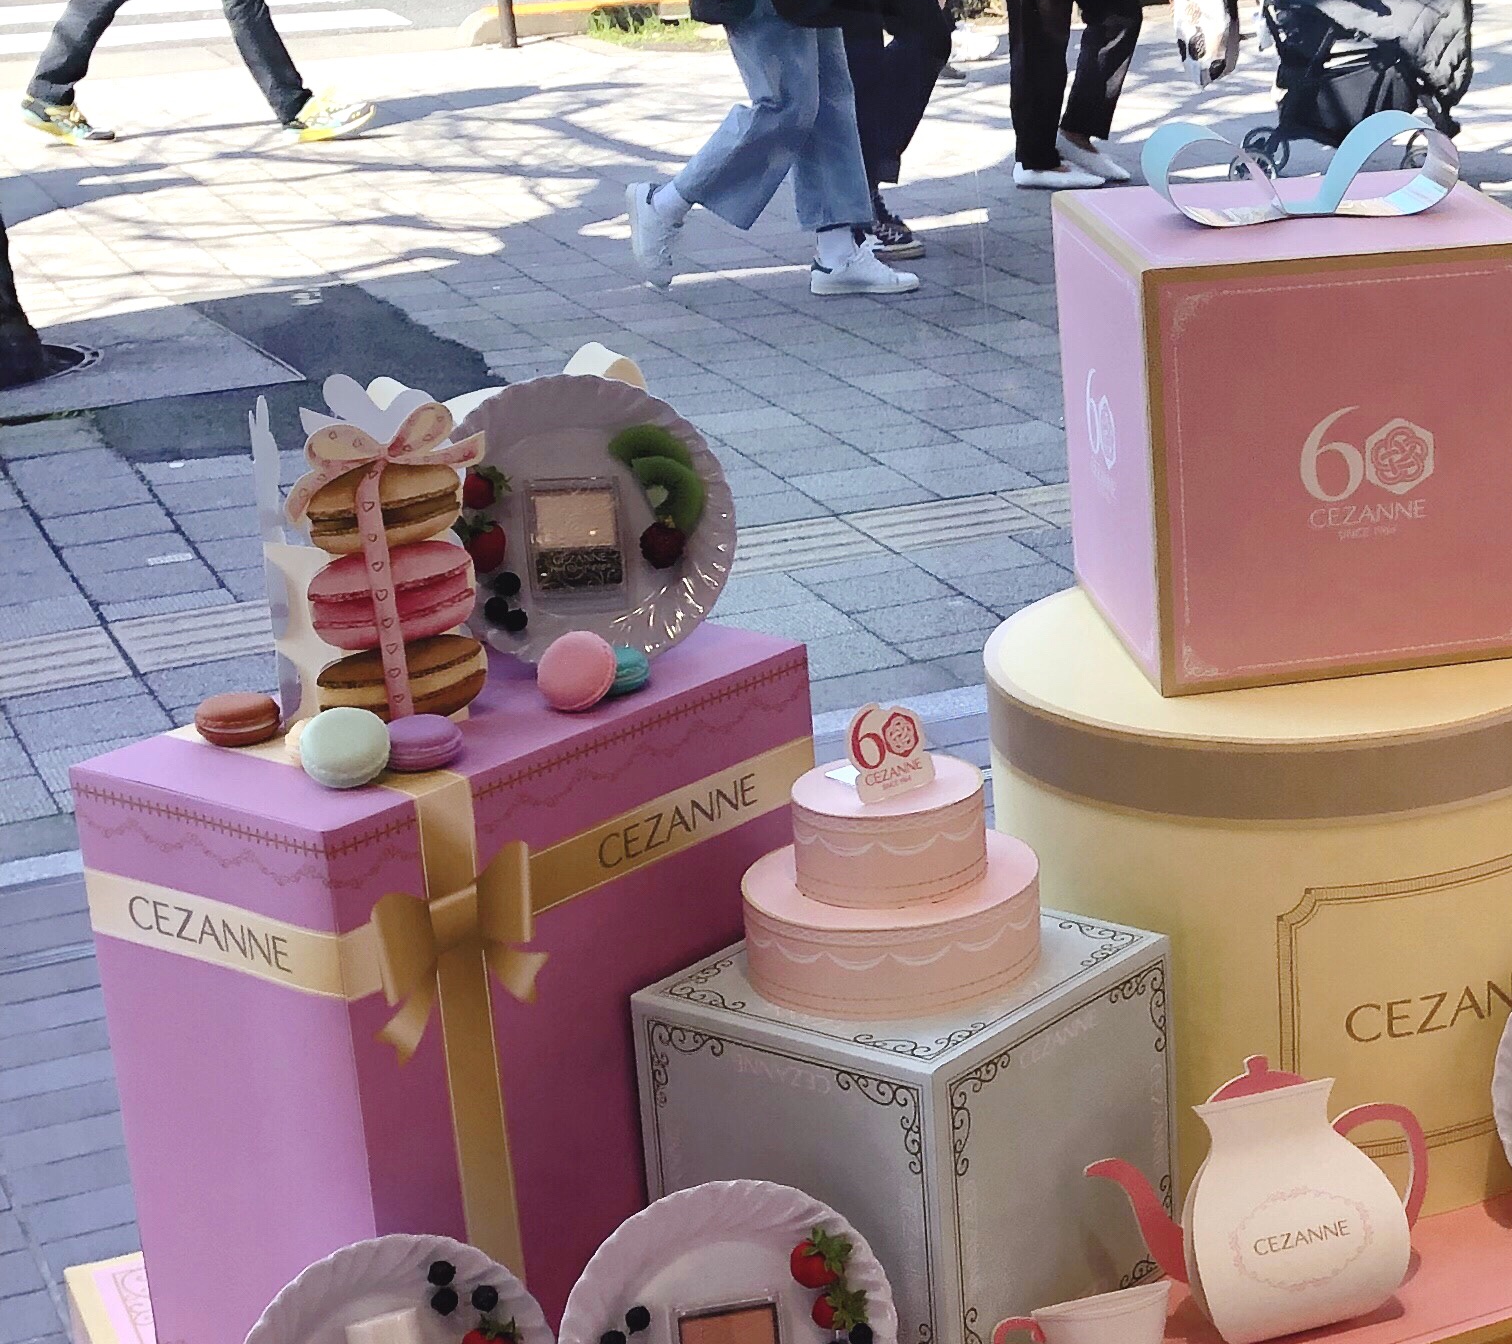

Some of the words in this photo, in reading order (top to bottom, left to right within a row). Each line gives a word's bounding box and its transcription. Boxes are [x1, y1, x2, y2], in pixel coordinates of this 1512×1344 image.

[1307, 498, 1427, 530] CEZANNE
[864, 757, 923, 787] CEZANNE
[597, 772, 759, 871] CEZANNE
[128, 895, 293, 974] CEZANNE
[1253, 1218, 1351, 1256] CEZANNE
